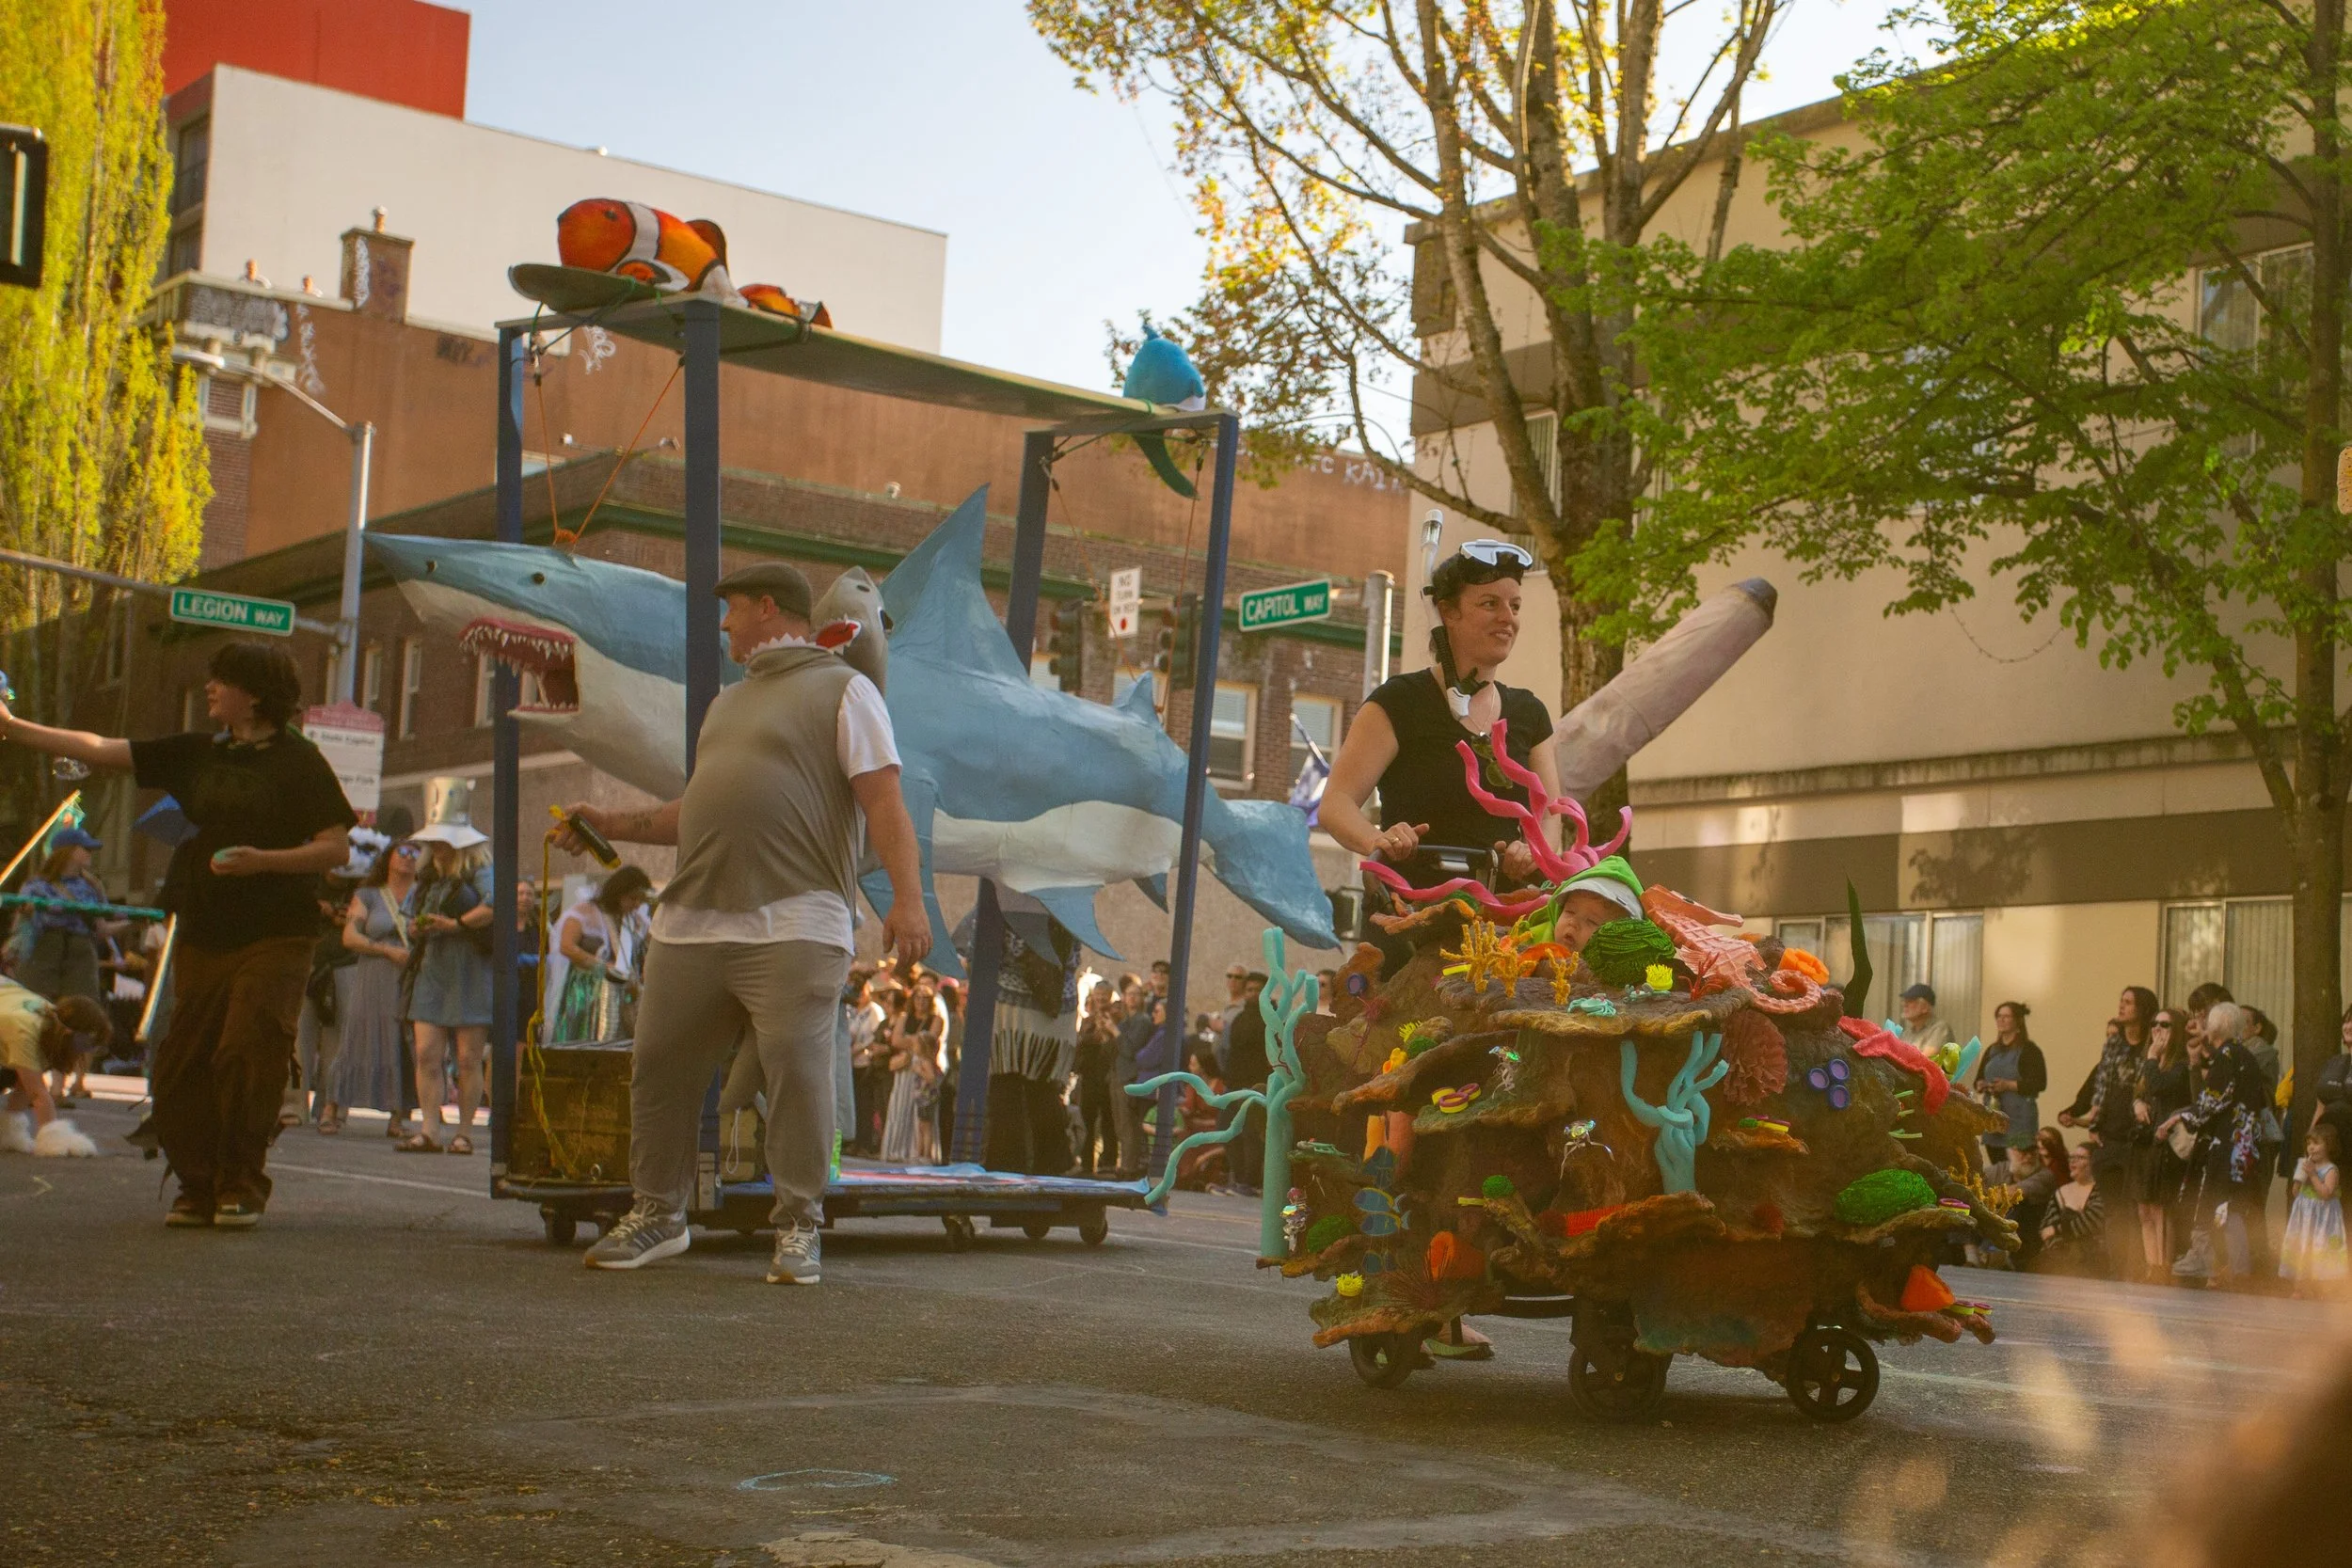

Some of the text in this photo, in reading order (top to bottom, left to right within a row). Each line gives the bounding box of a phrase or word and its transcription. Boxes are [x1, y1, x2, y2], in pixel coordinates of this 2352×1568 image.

[179, 594, 284, 626] LEGION WAY
[1246, 593, 1327, 622] CAPITOL WAY
